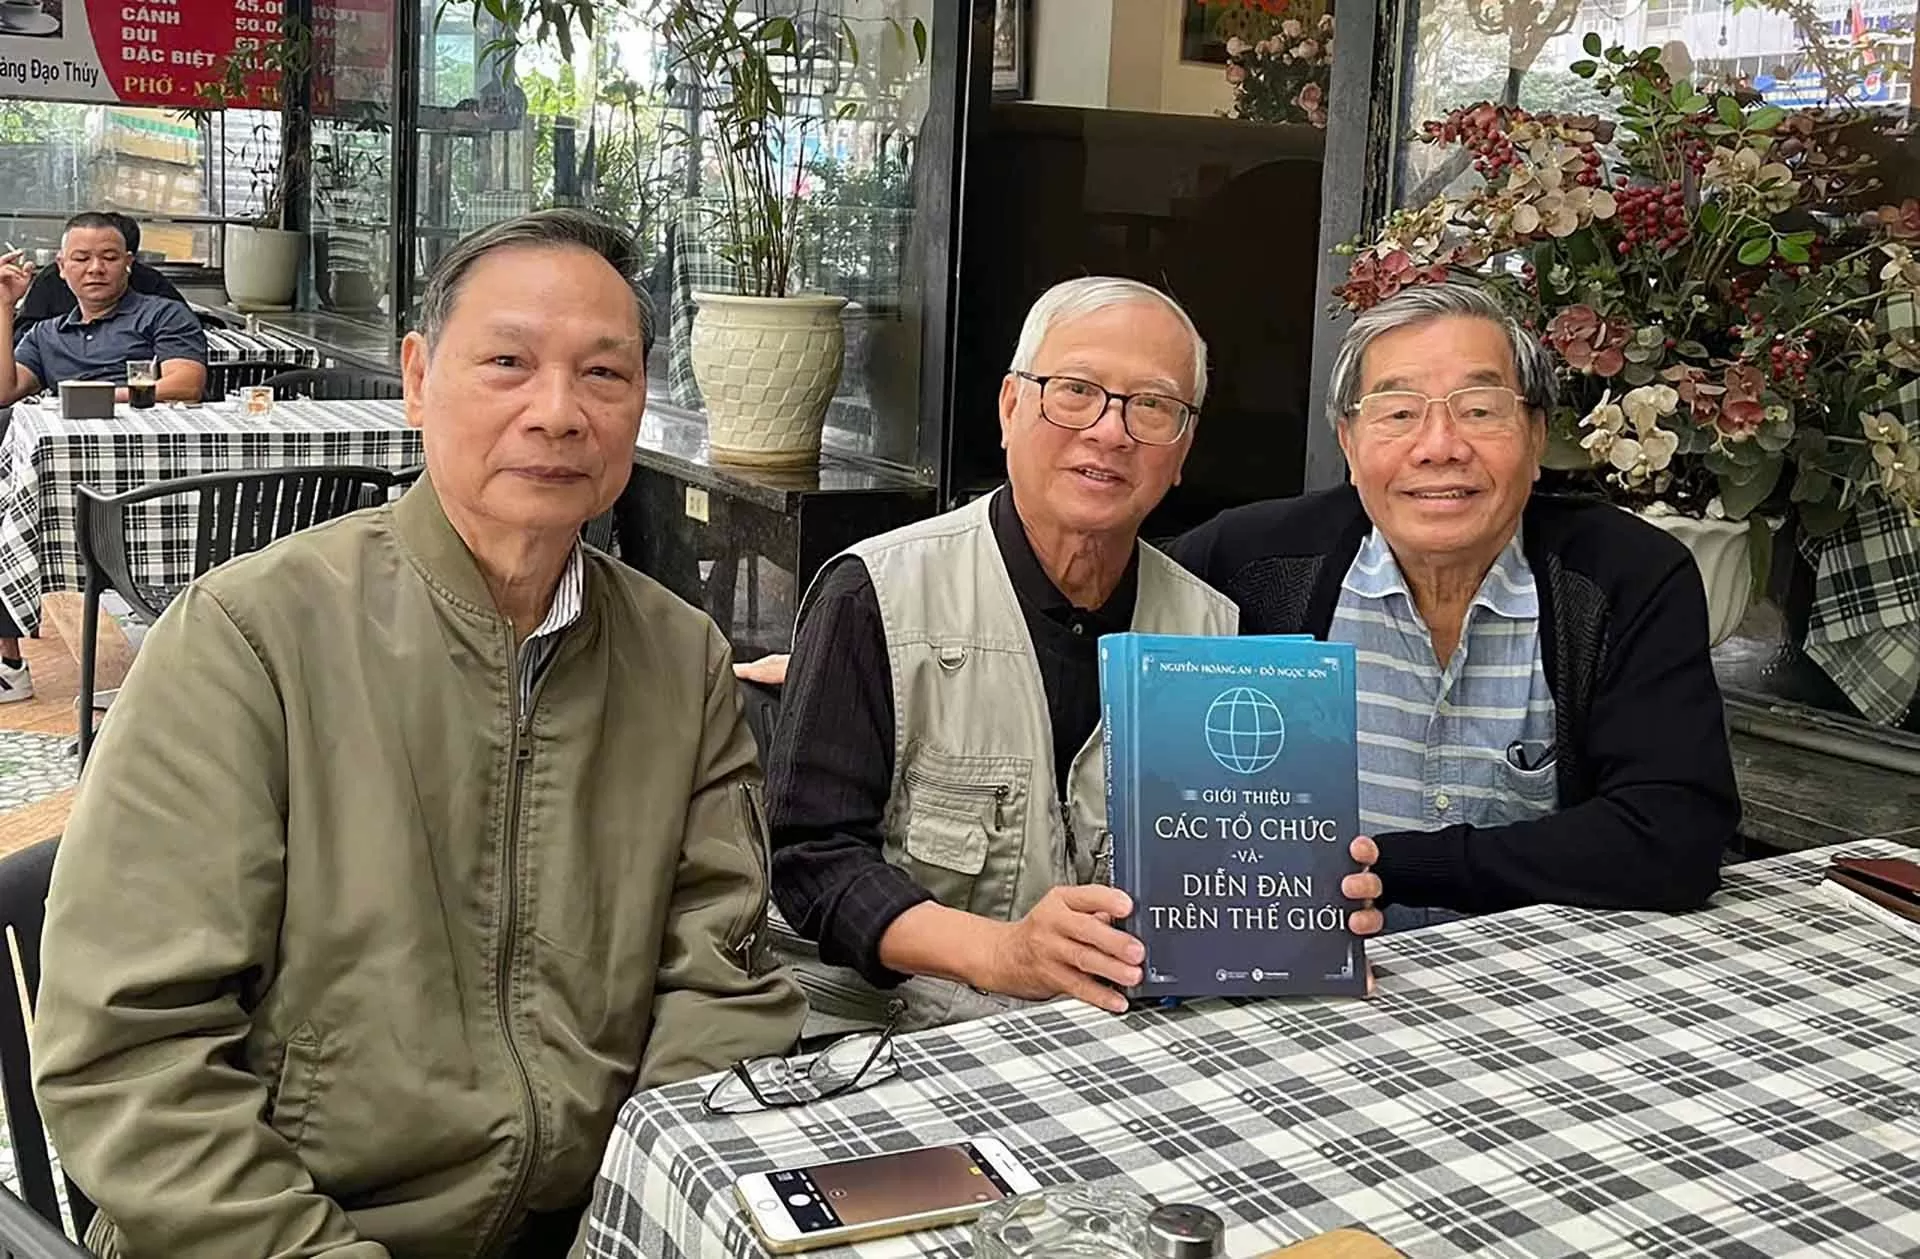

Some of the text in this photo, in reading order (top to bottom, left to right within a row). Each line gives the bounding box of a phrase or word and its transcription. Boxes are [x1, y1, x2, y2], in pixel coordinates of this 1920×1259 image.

[121, 6, 180, 24] CÁNH
[122, 46, 165, 64] ĐẶC
[171, 49, 216, 68] BIỆT
[31, 58, 59, 85] Đạo
[63, 61, 99, 88] Thúy
[1203, 788, 1290, 806] GIỚI THIỆU
[1155, 810, 1337, 841] CÁC TỔ CHỨC
[1183, 867, 1312, 897] DIỄN ĐÀN
[1149, 902, 1345, 930] TRÊN THẾ GIỚI
